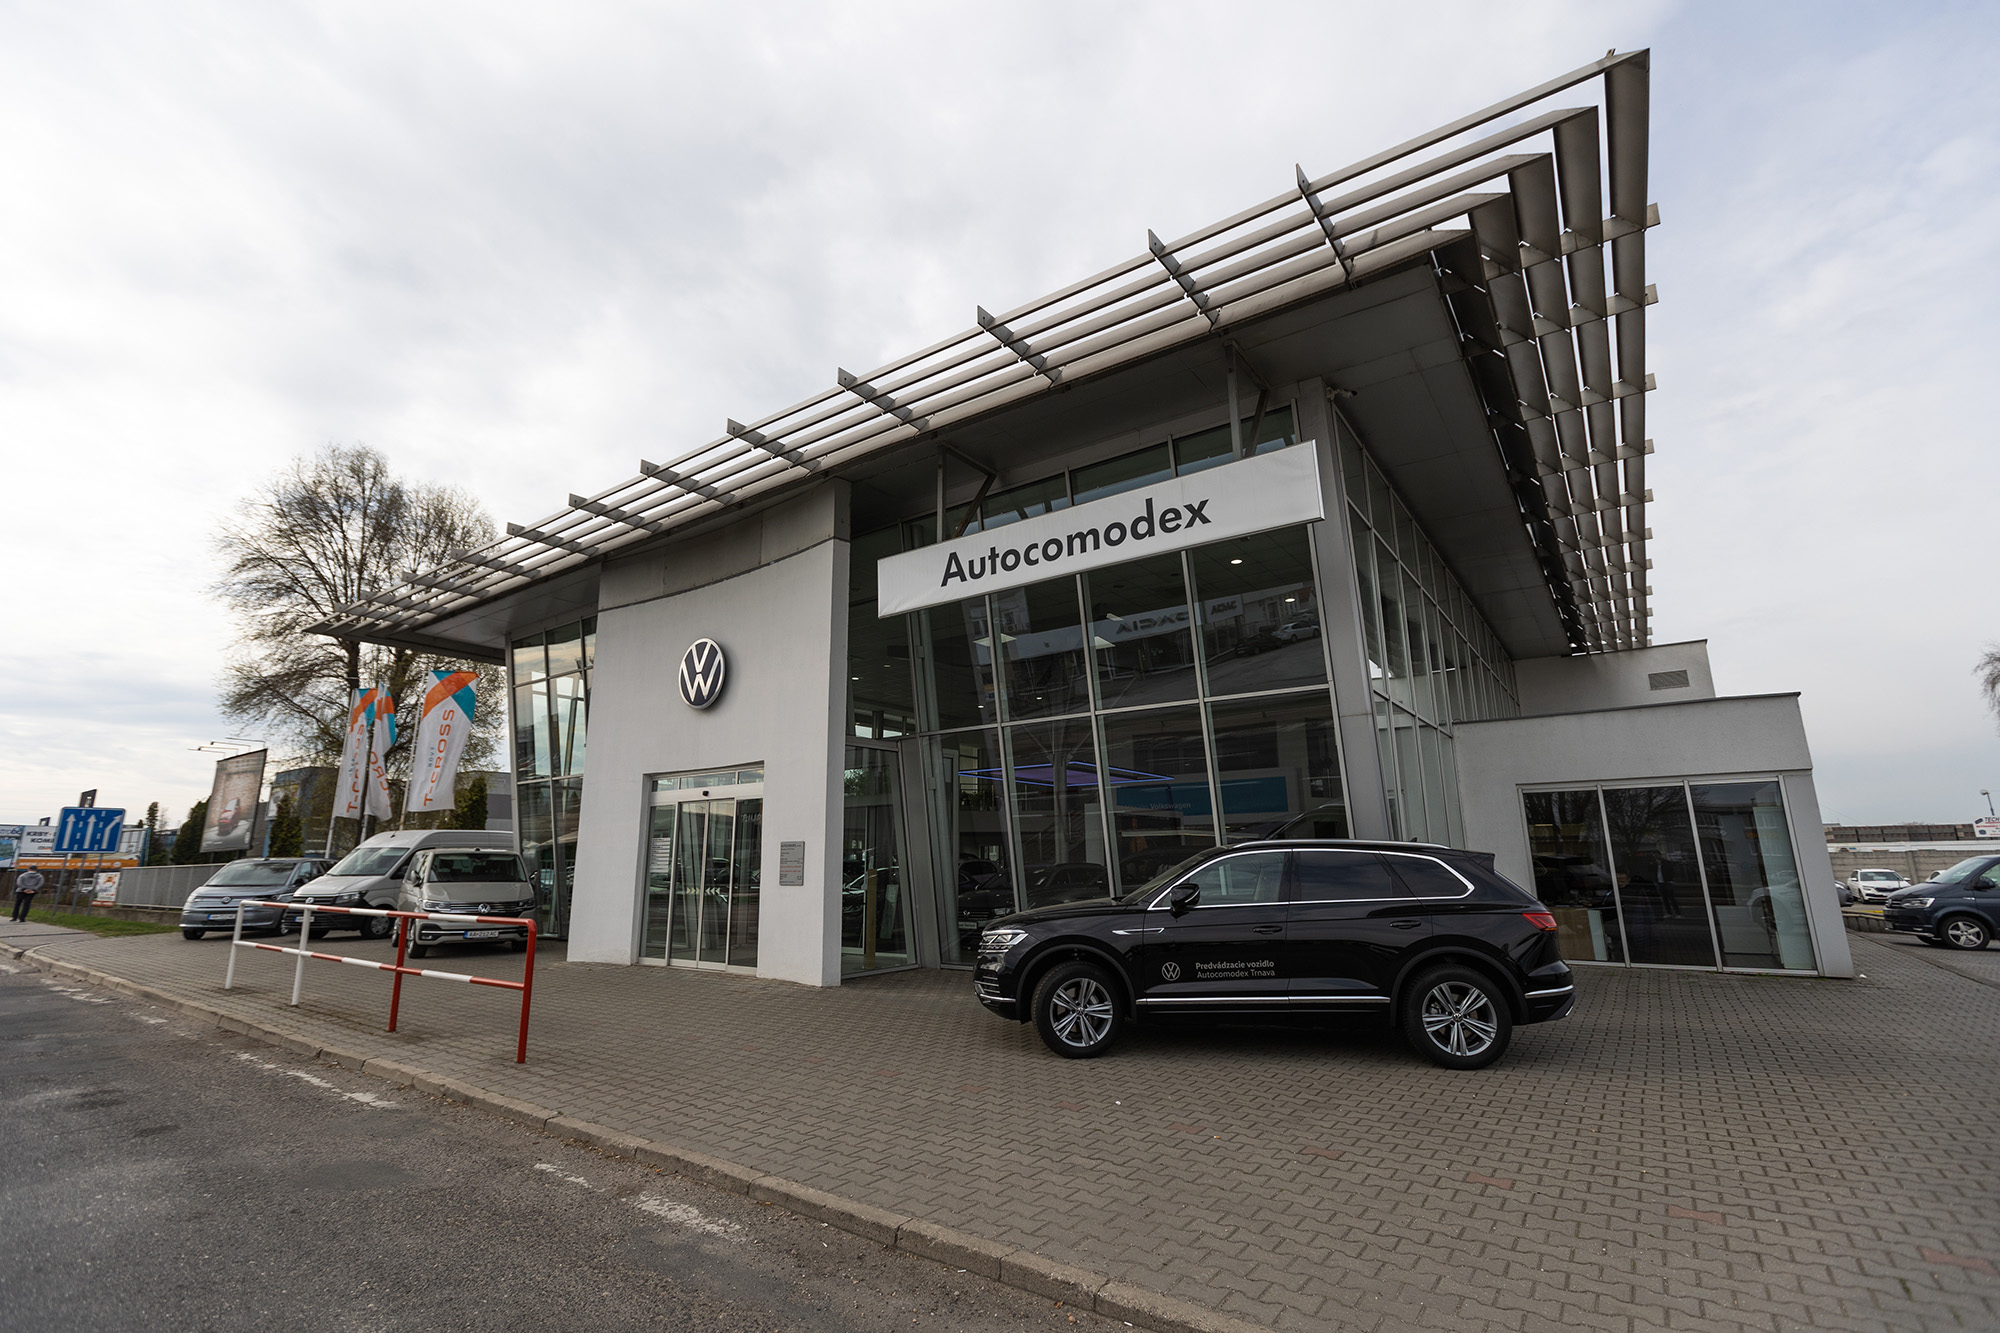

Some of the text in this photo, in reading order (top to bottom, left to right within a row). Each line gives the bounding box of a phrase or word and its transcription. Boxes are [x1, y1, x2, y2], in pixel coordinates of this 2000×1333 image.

[940, 498, 1212, 587] Autocomodex
[423, 709, 455, 807] T-CROSS
[1150, 802, 1191, 810] Volkswagen
[1195, 959, 1275, 970] Predvádzacie vozidlo
[1197, 969, 1275, 979] Autocomodex Trnava
